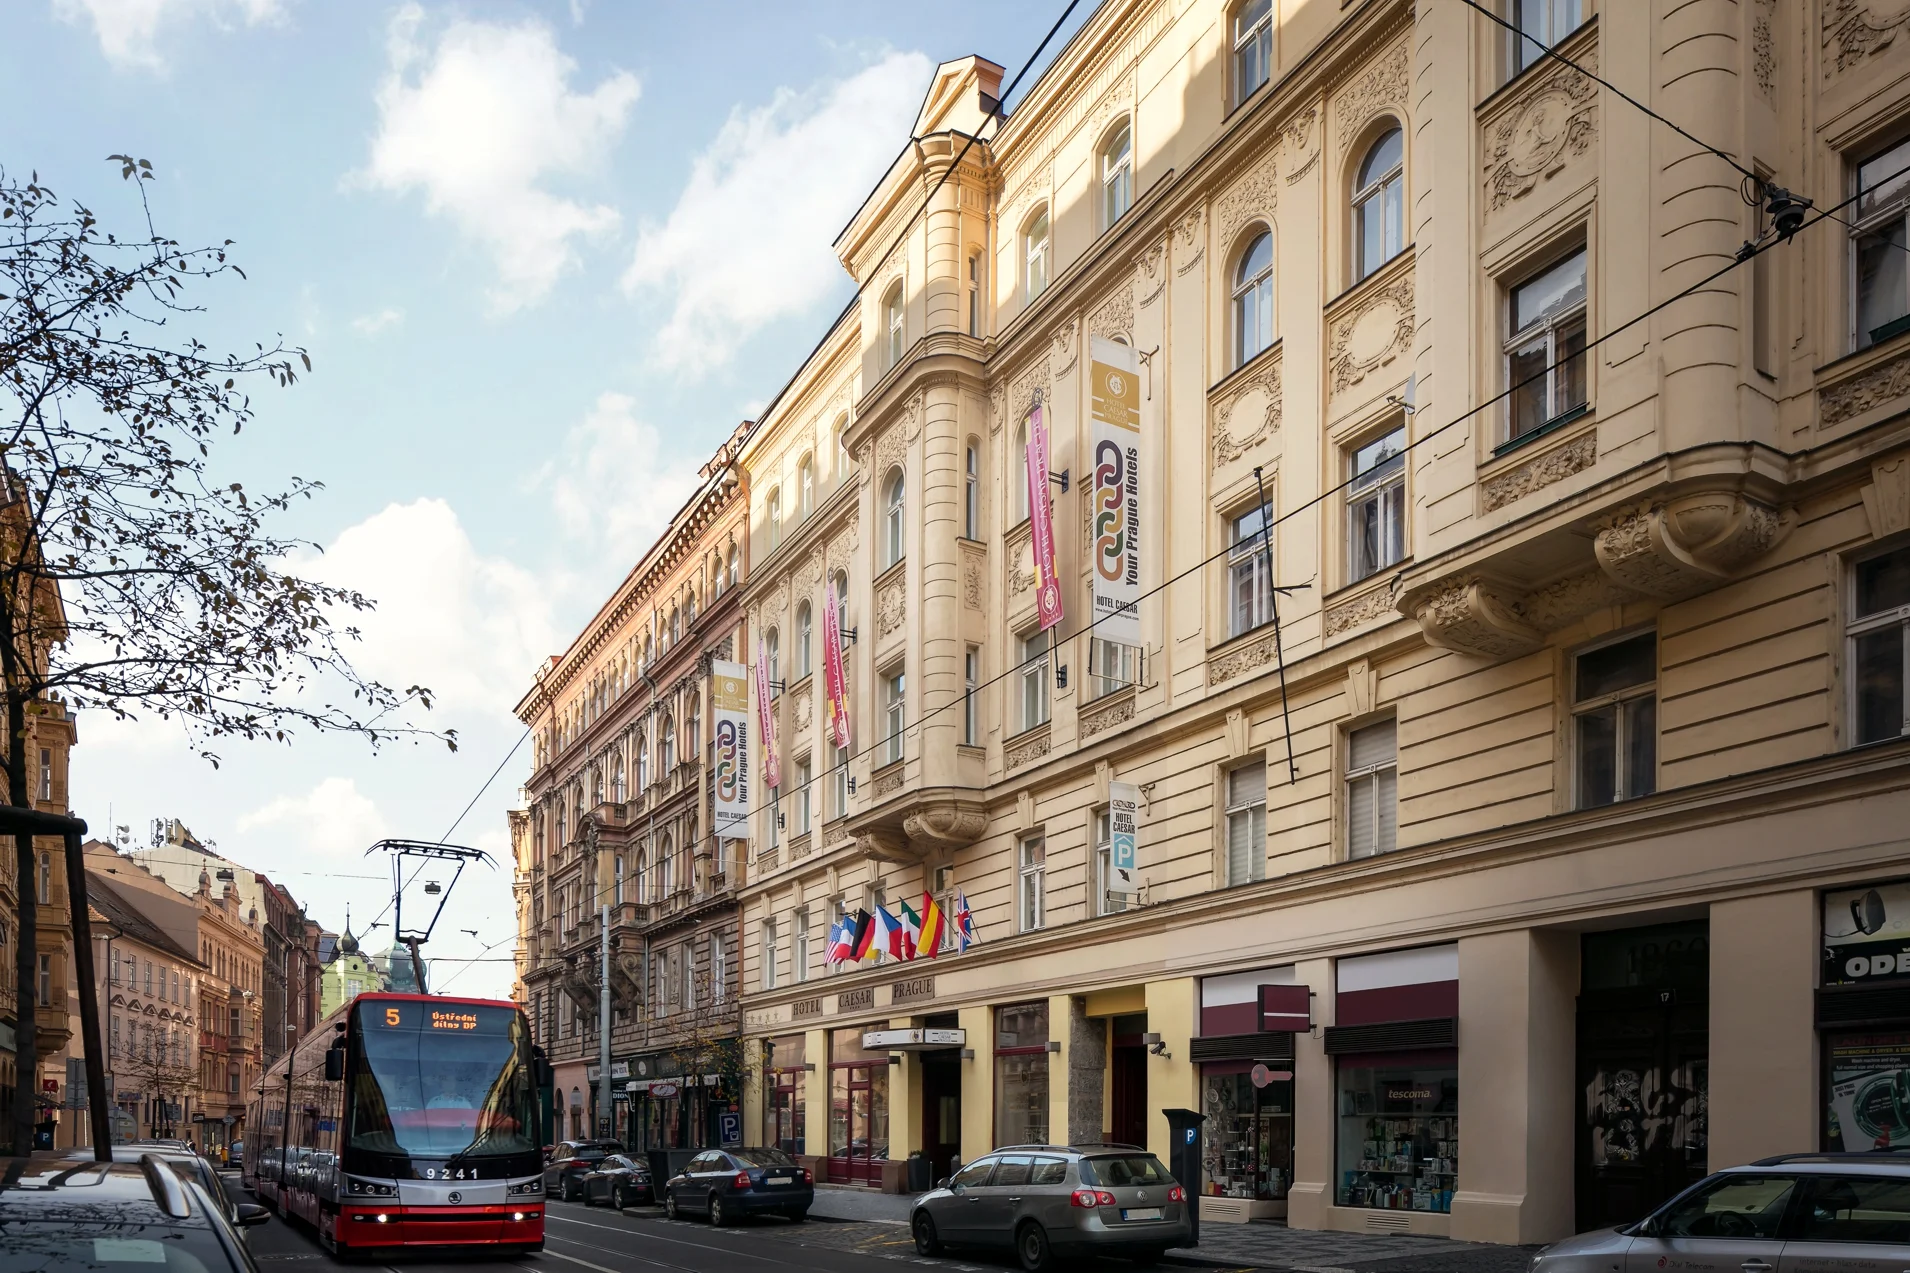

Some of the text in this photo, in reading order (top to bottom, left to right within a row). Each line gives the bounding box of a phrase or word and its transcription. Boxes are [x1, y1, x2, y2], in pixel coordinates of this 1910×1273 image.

[1106, 398, 1126, 409] HOTEL
[1104, 404, 1129, 419] CAESAR
[1125, 447, 1139, 586] Your Prague Hotels
[1096, 594, 1138, 614] HOTEL CAESAR
[737, 721, 748, 804] Your Prague Hotels
[717, 811, 730, 819] HOTEL
[1115, 812, 1132, 824] HOTEL
[1113, 821, 1135, 834] CAESAR
[1118, 843, 1131, 865] P
[792, 978, 932, 1015] HOTEL CAESAR PRAGUE
[1660, 992, 1670, 1002] 17
[385, 1008, 401, 1027] 5
[432, 1011, 477, 1022] Ústřední
[432, 1020, 477, 1030] dílny DP
[724, 1117, 736, 1135] P
[42, 1132, 49, 1141] P
[1187, 1129, 1194, 1142] P
[1685, 1261, 1715, 1270] Telecom
[1858, 1260, 1876, 1268] data
